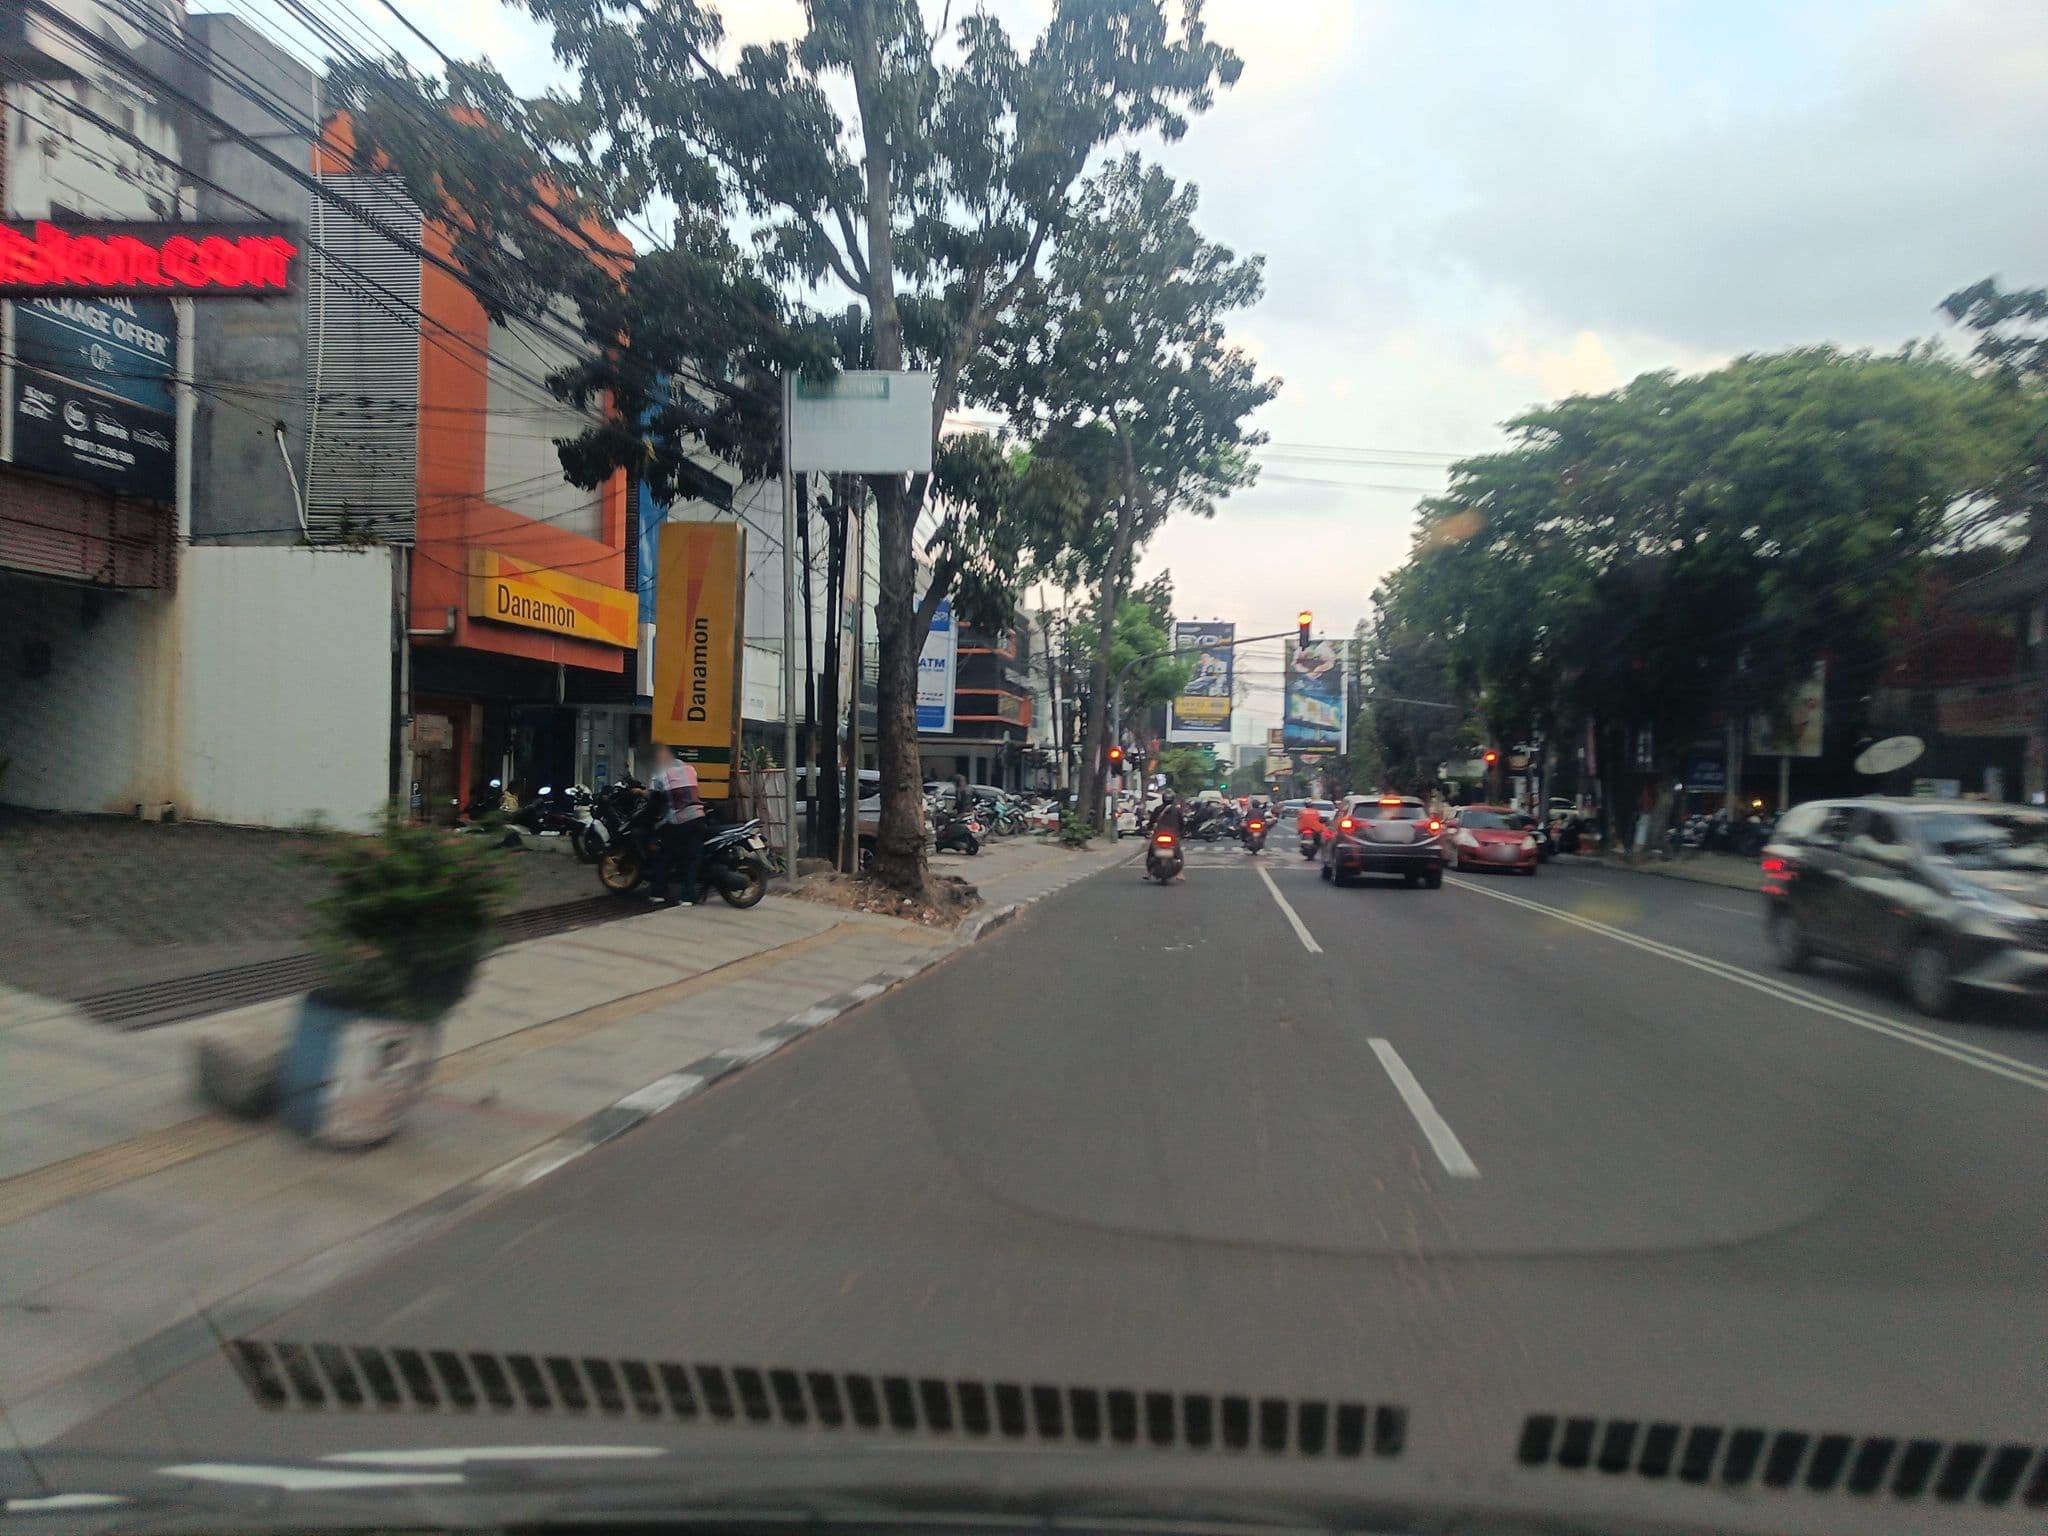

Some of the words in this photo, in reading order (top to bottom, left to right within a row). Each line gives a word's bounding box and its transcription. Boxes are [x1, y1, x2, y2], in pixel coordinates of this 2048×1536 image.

[22, 297, 111, 334] ACKAGE
[498, 584, 575, 628] Danamon
[688, 618, 709, 722] Danamon
[919, 658, 946, 668] ATM
